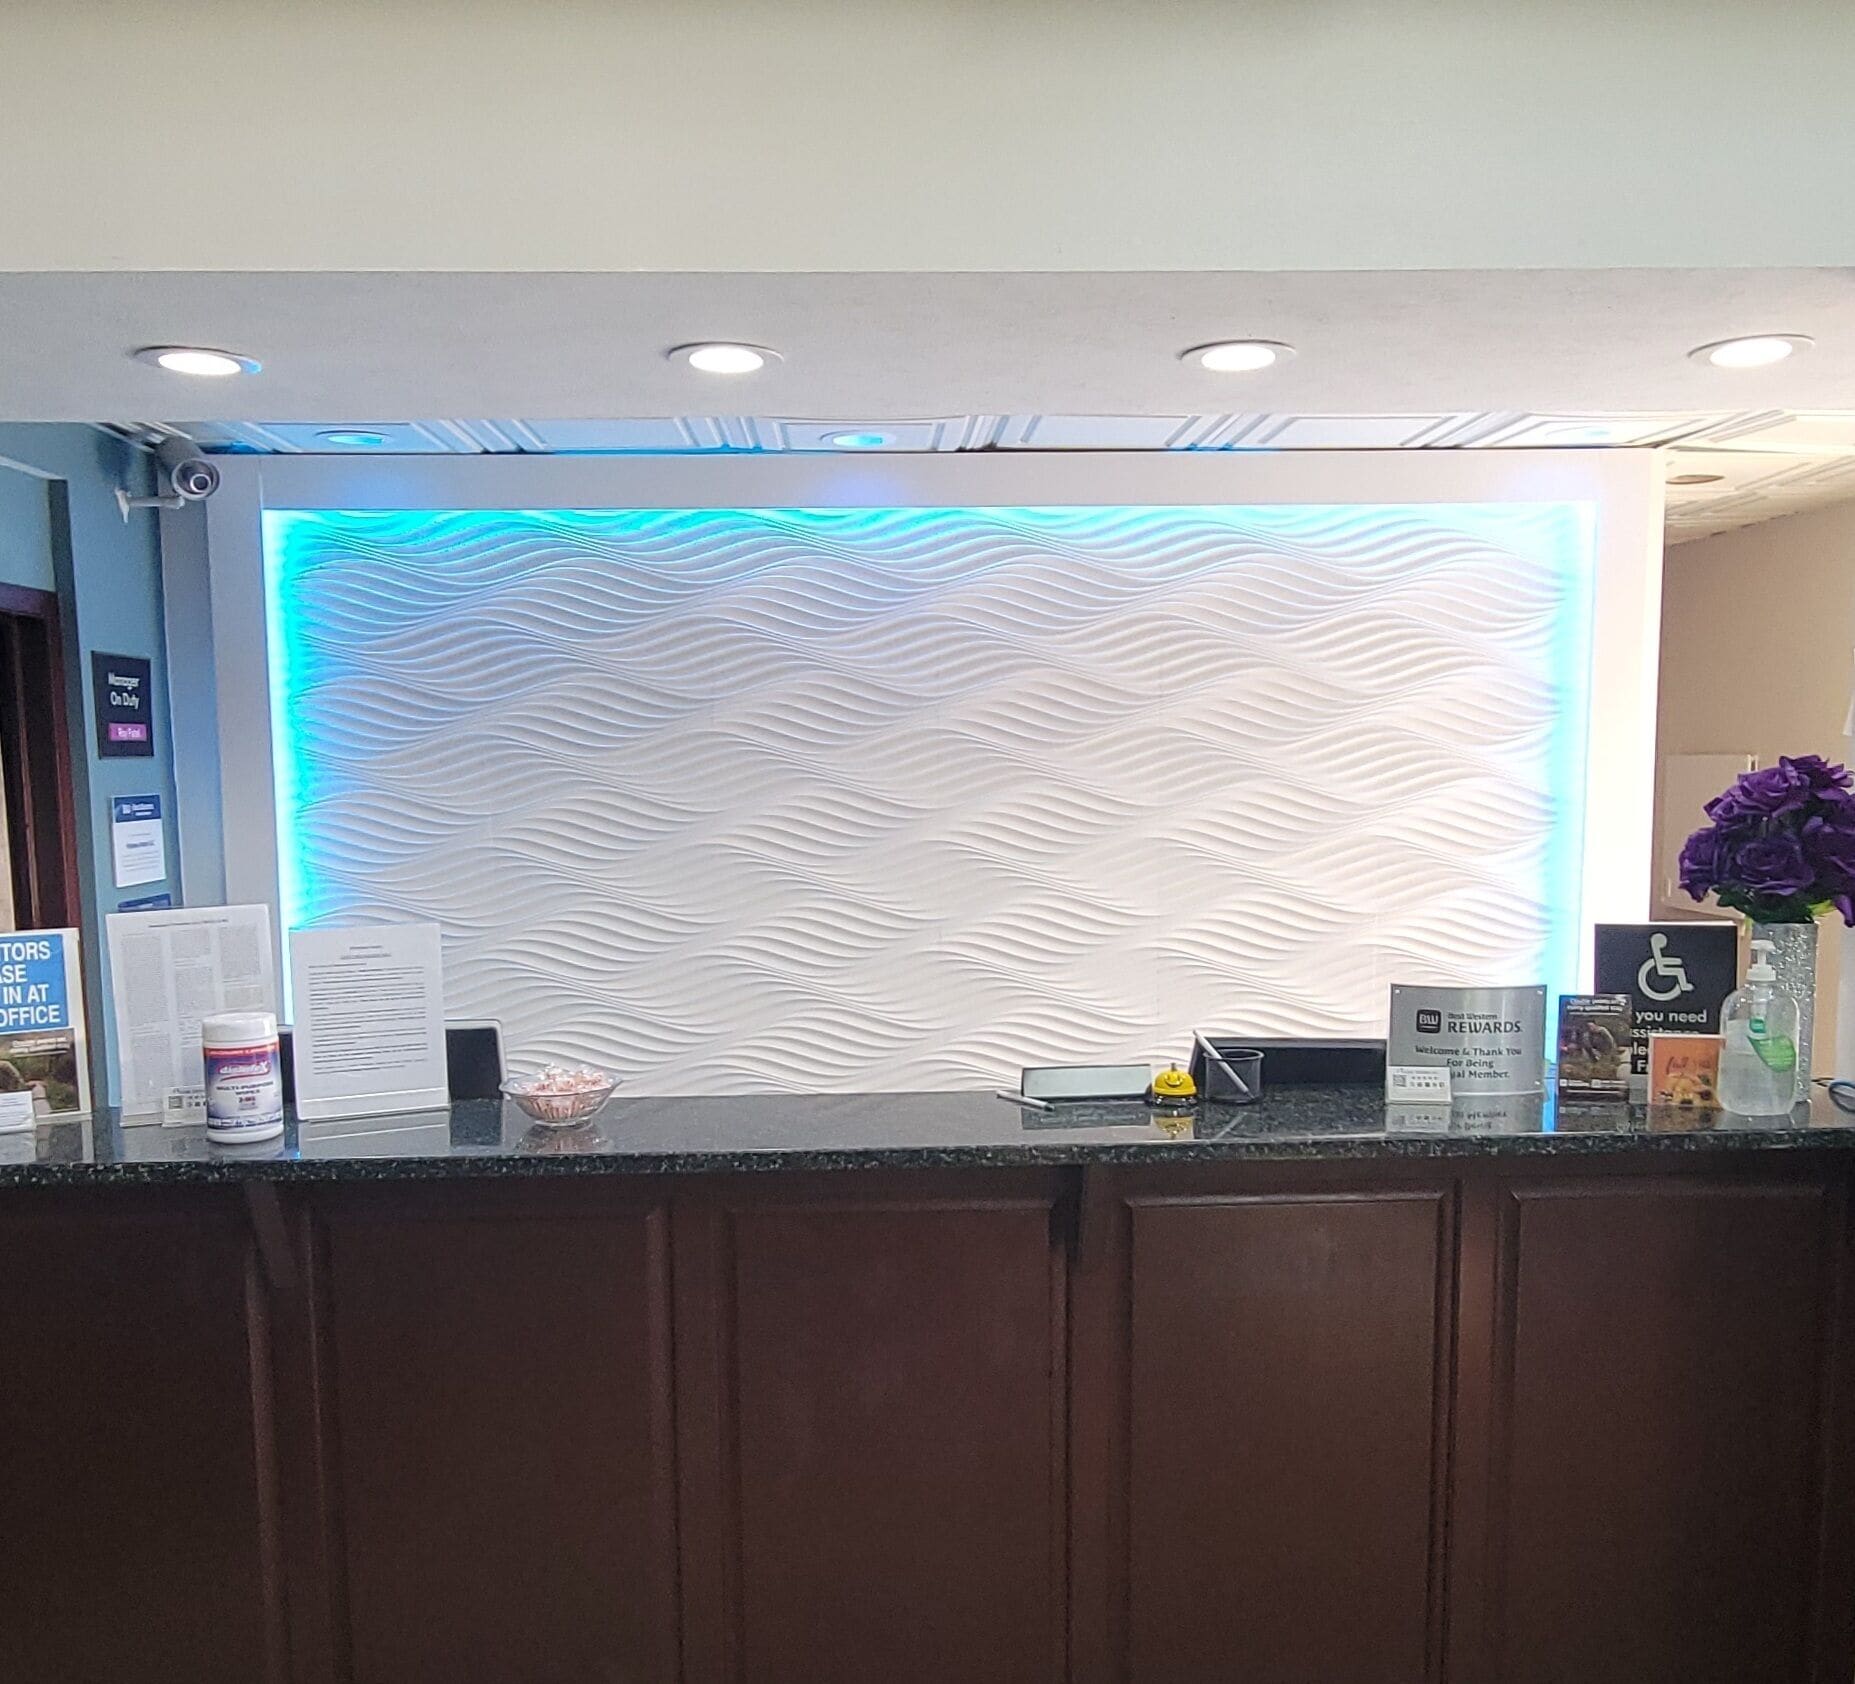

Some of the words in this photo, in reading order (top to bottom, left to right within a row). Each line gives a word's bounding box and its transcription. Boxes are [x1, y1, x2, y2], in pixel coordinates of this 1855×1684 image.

[110, 691, 122, 706] On
[122, 692, 141, 710] Duty
[0, 940, 51, 962] TORS
[0, 964, 28, 984] SE
[3, 985, 22, 1005] IN
[27, 983, 50, 1004] AT
[1635, 1011, 1664, 1024] you
[1668, 1009, 1707, 1023] need
[1447, 1021, 1521, 1034] REWARDS
[1415, 1045, 1460, 1056] Welcome
[1473, 1047, 1504, 1056] Thank
[1505, 1047, 1522, 1056] You
[1446, 1058, 1463, 1067] For
[1465, 1058, 1495, 1069] Being
